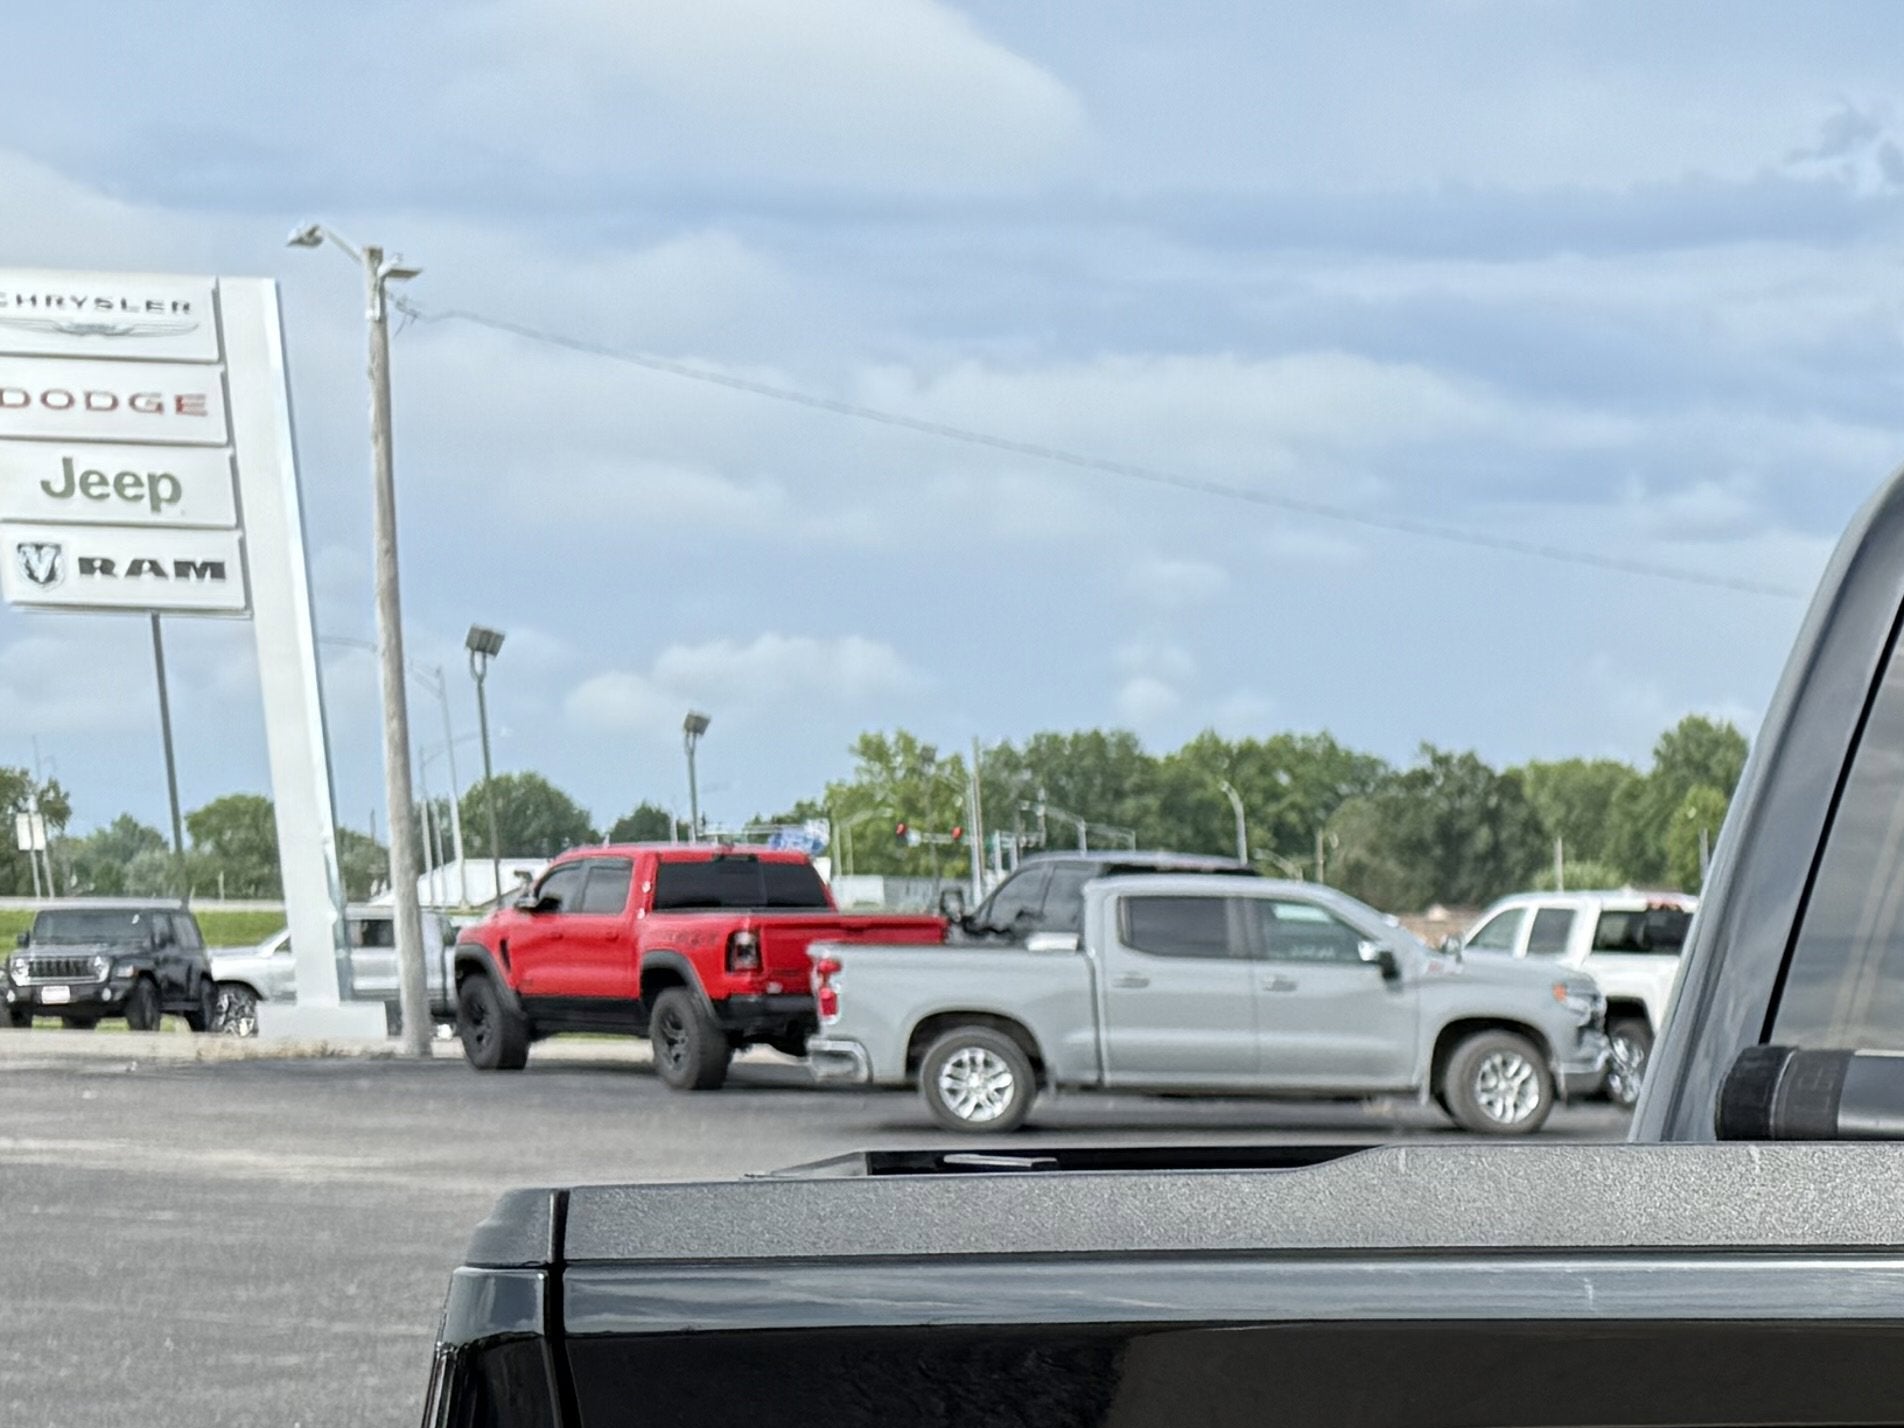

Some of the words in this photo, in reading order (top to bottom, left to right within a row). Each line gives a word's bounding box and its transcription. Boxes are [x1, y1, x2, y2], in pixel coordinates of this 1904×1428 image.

[0, 387, 208, 416] DODGE
[40, 457, 183, 513] Jeep
[78, 556, 226, 582] RAM
